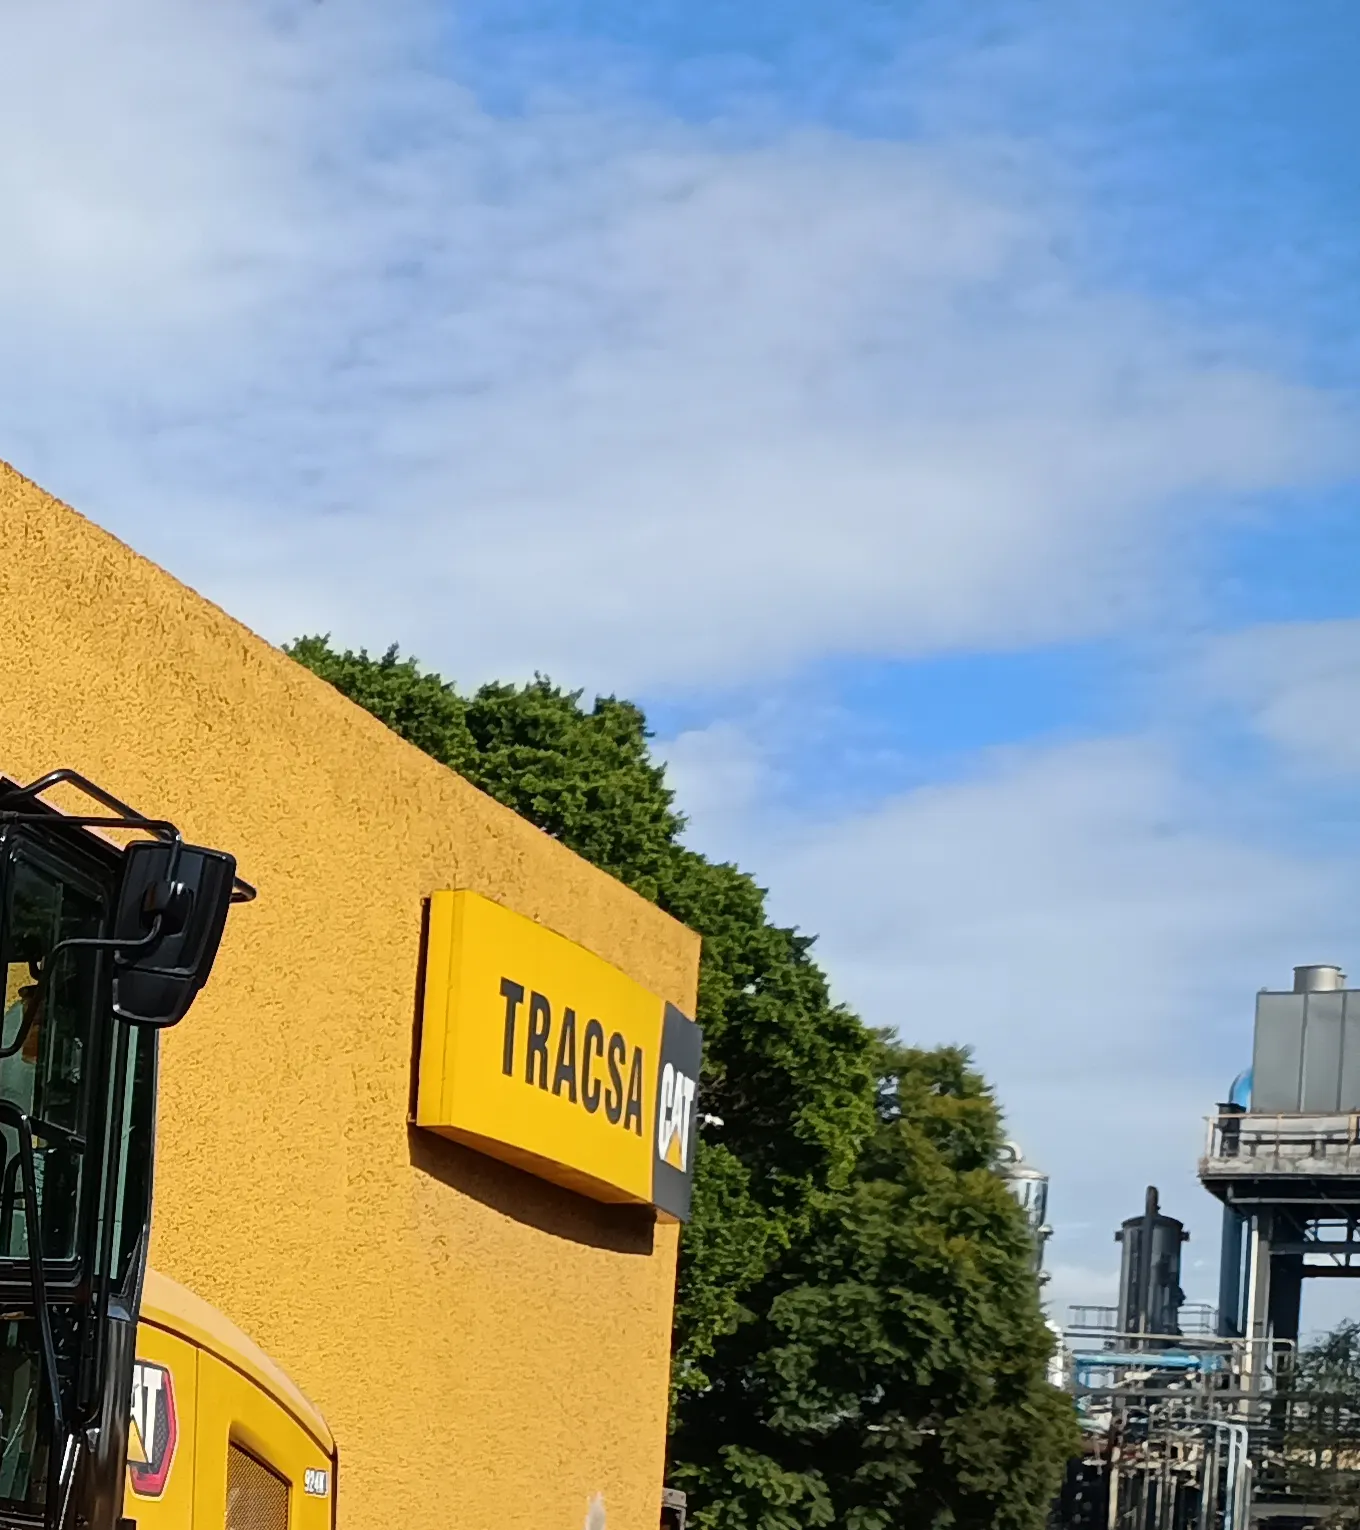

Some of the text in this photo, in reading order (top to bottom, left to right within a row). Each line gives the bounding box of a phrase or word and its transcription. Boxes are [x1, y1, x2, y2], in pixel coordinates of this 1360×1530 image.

[499, 976, 643, 1138] TRACSA
[658, 1062, 696, 1174] CAT
[129, 1364, 163, 1464] AT
